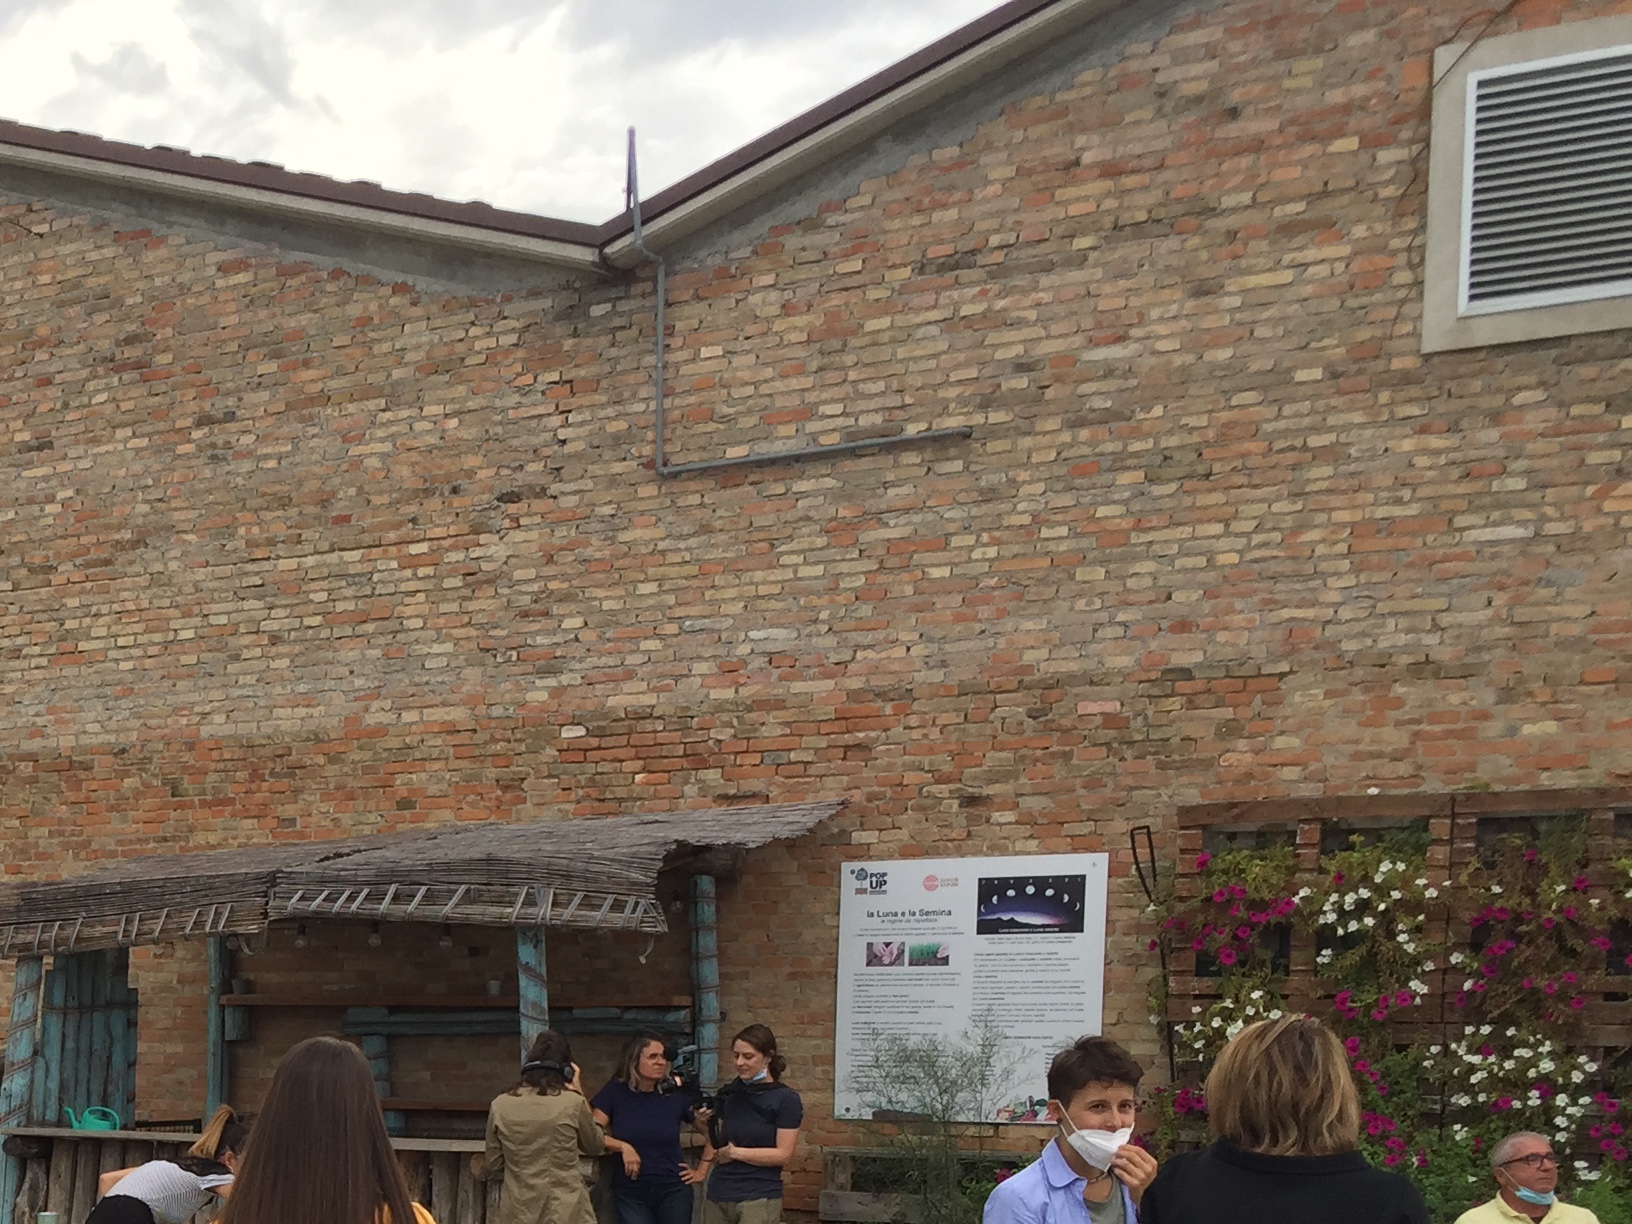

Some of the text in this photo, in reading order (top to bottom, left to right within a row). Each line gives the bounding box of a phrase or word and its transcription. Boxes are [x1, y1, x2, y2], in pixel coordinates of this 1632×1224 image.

[869, 872, 887, 880] POP
[869, 880, 887, 889] UP
[866, 910, 875, 918] la
[876, 910, 899, 918] Luna
[908, 909, 917, 917] la
[918, 908, 952, 917] Semina
